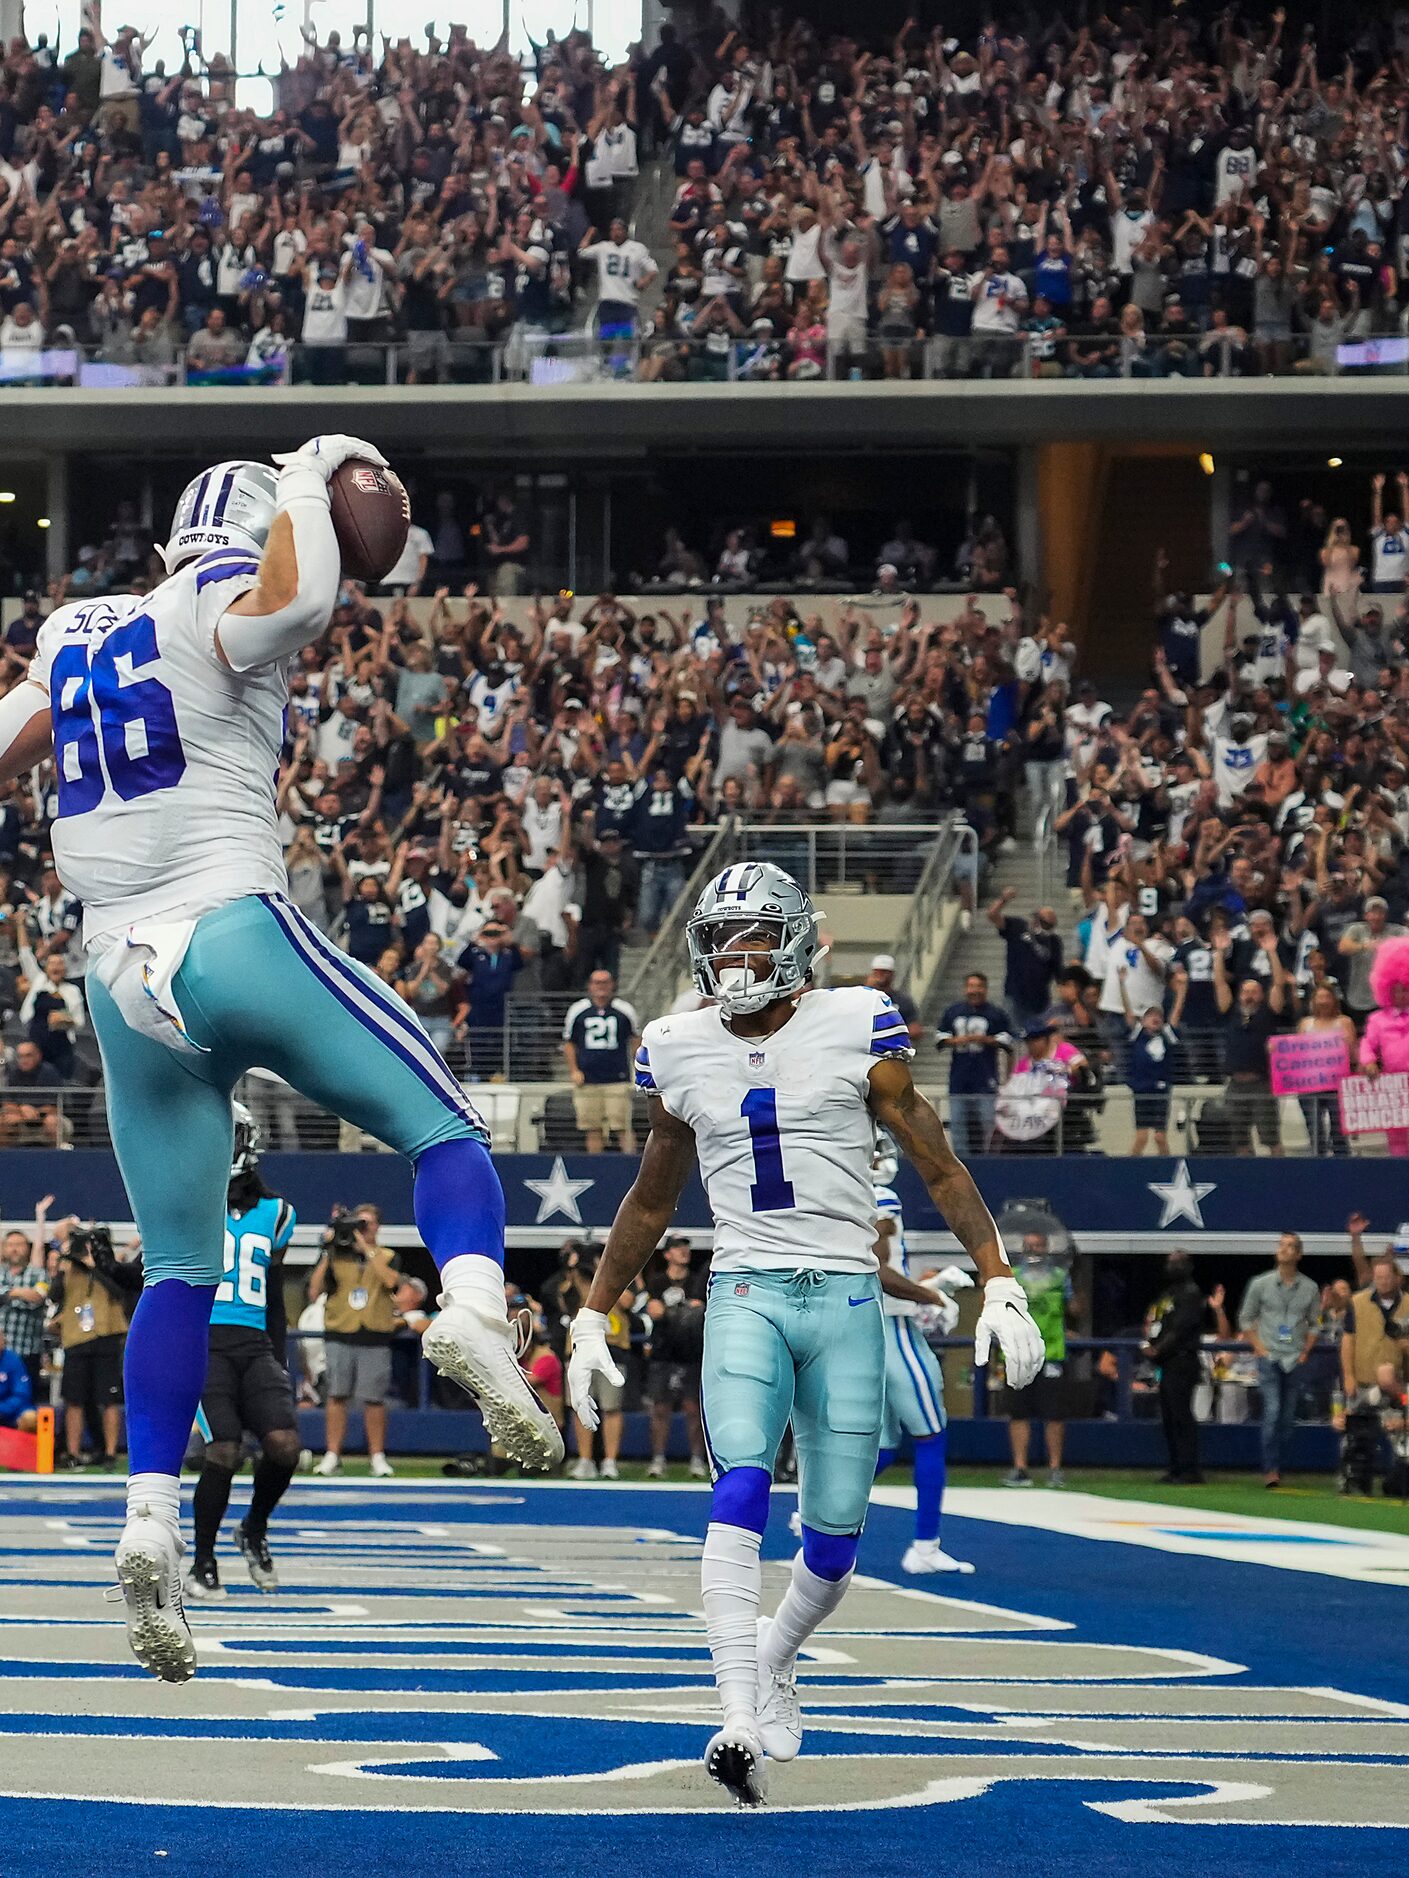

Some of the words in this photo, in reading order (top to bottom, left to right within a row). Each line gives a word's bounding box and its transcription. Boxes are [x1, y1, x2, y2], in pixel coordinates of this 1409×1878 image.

[607, 254, 630, 277] 21
[357, 471, 377, 490] NFL
[50, 613, 187, 818] 86
[649, 792, 673, 816] 11
[1141, 887, 1157, 916] 9
[584, 1016, 618, 1050] 21
[1276, 1035, 1343, 1054] Breast
[1276, 1055, 1345, 1072] Cancer
[741, 1088, 795, 1212] 1
[215, 1232, 272, 1307] 26
